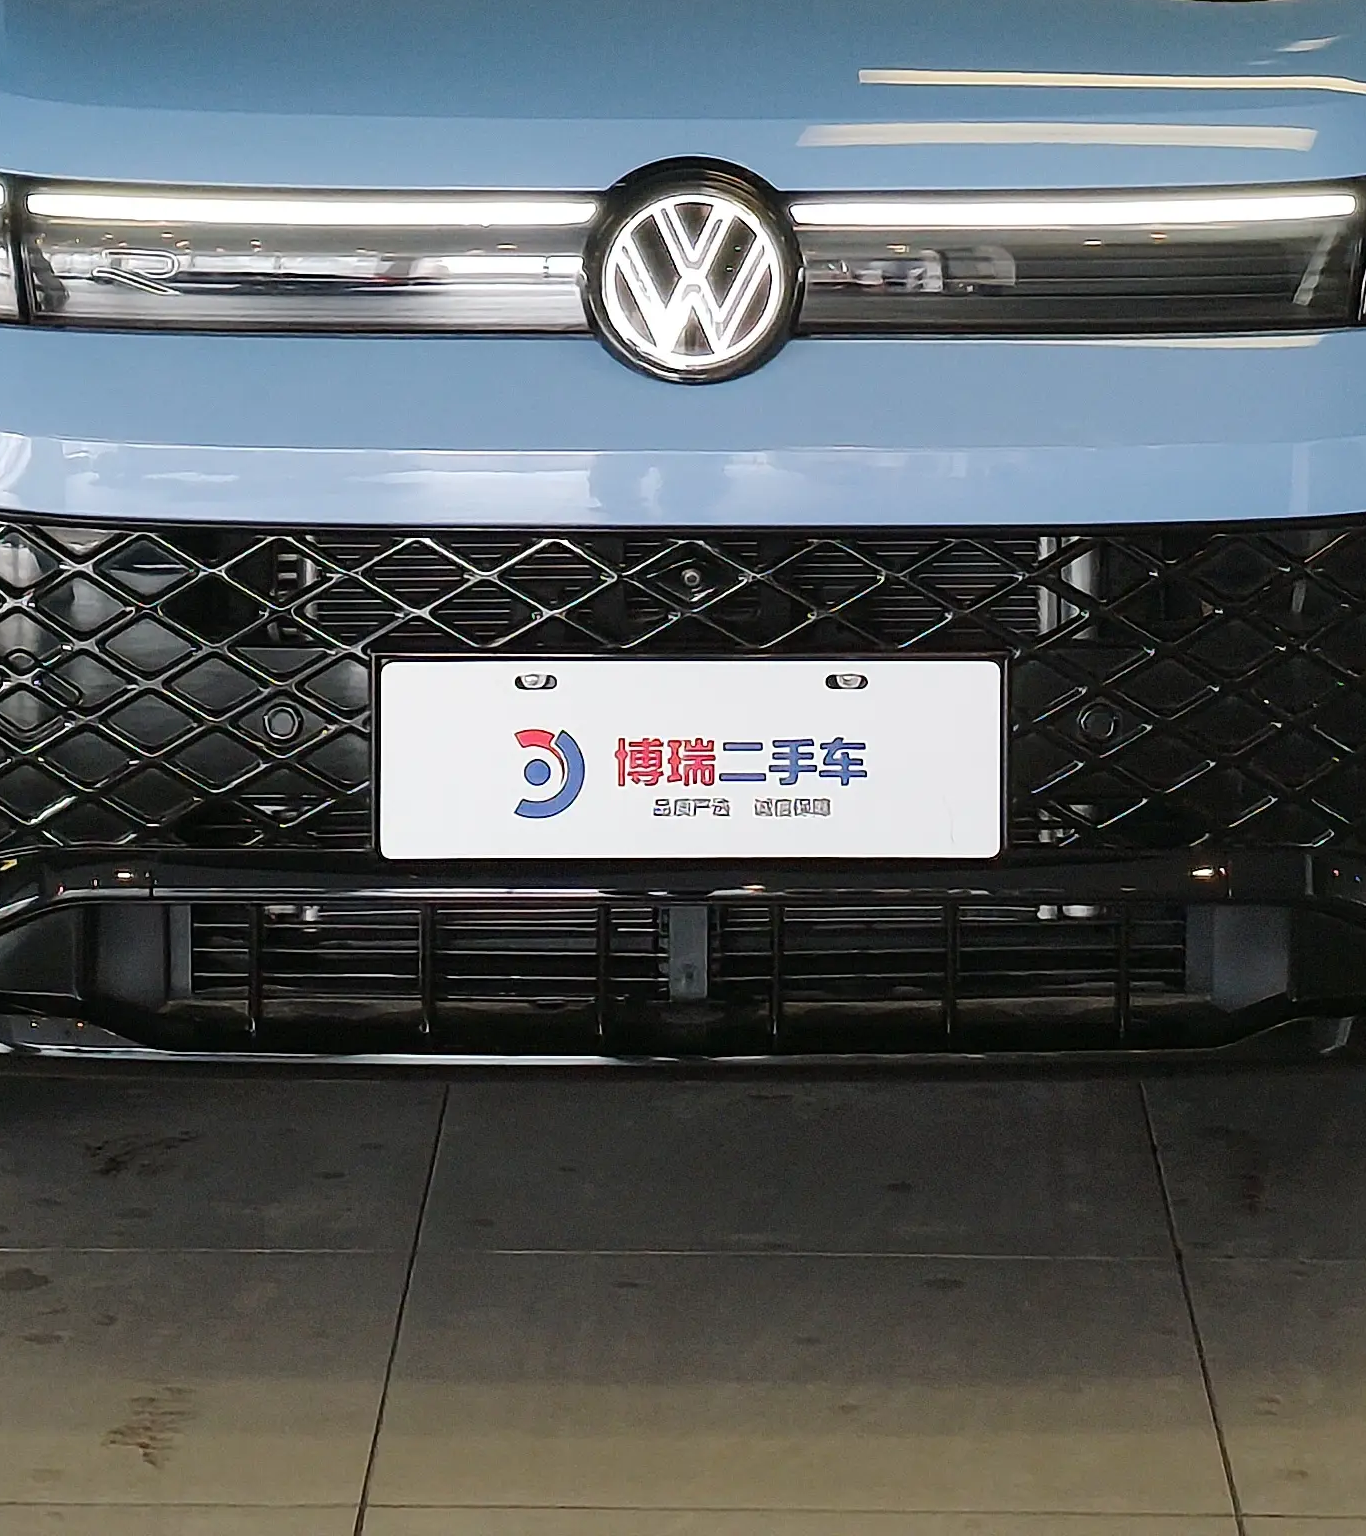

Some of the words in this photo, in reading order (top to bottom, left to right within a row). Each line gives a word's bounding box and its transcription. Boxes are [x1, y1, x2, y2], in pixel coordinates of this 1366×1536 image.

[602, 193, 783, 369] VW
[614, 737, 868, 787] 博瑞二手车
